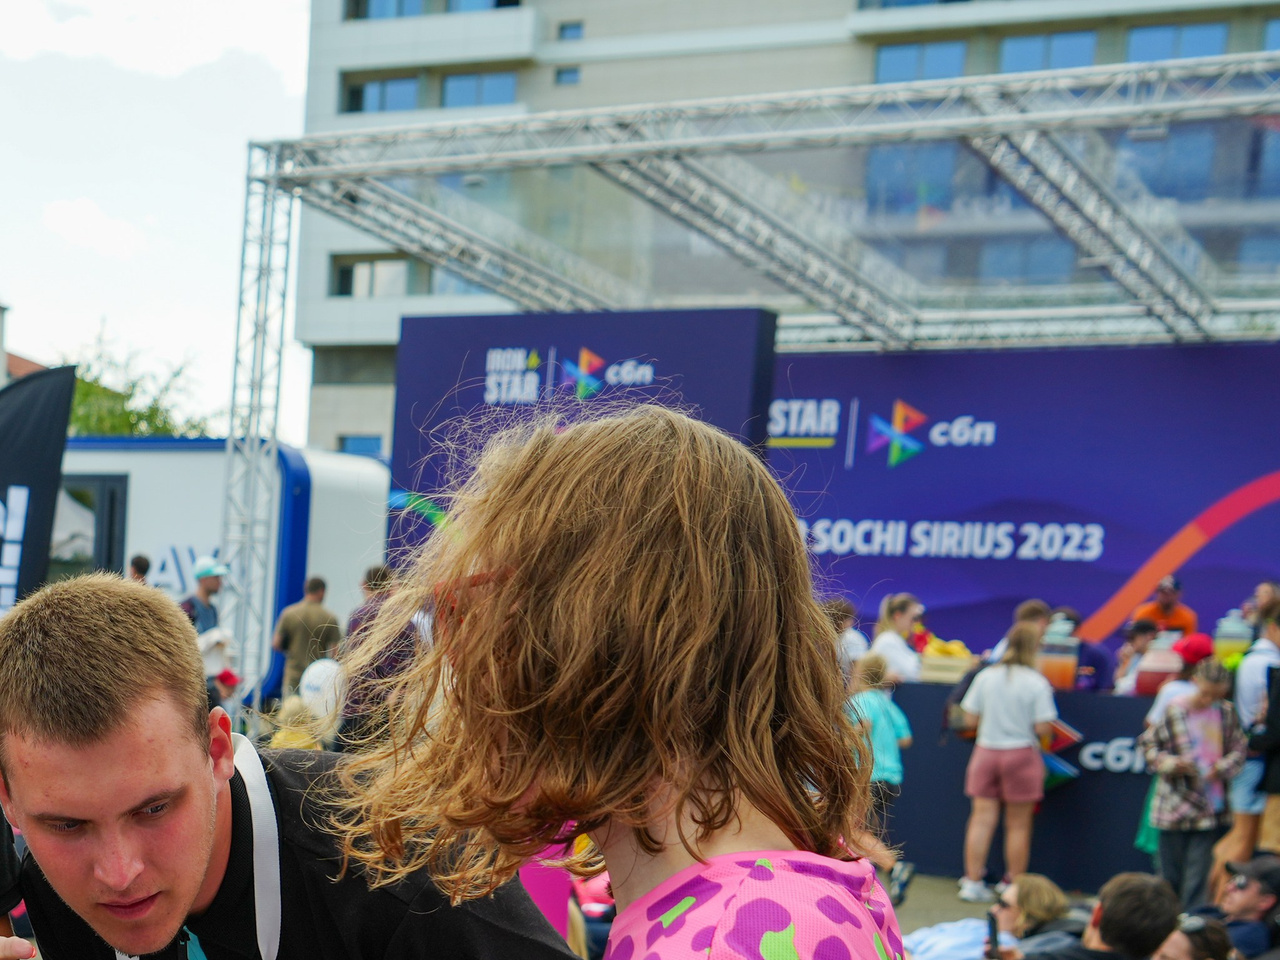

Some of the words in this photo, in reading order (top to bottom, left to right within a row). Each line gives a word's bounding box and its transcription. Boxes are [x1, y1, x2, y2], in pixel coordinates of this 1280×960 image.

[767, 399, 841, 436] STAR
[812, 518, 907, 556] SOCHI
[909, 520, 1015, 560] SIRIUS
[1016, 522, 1105, 563] 2023
